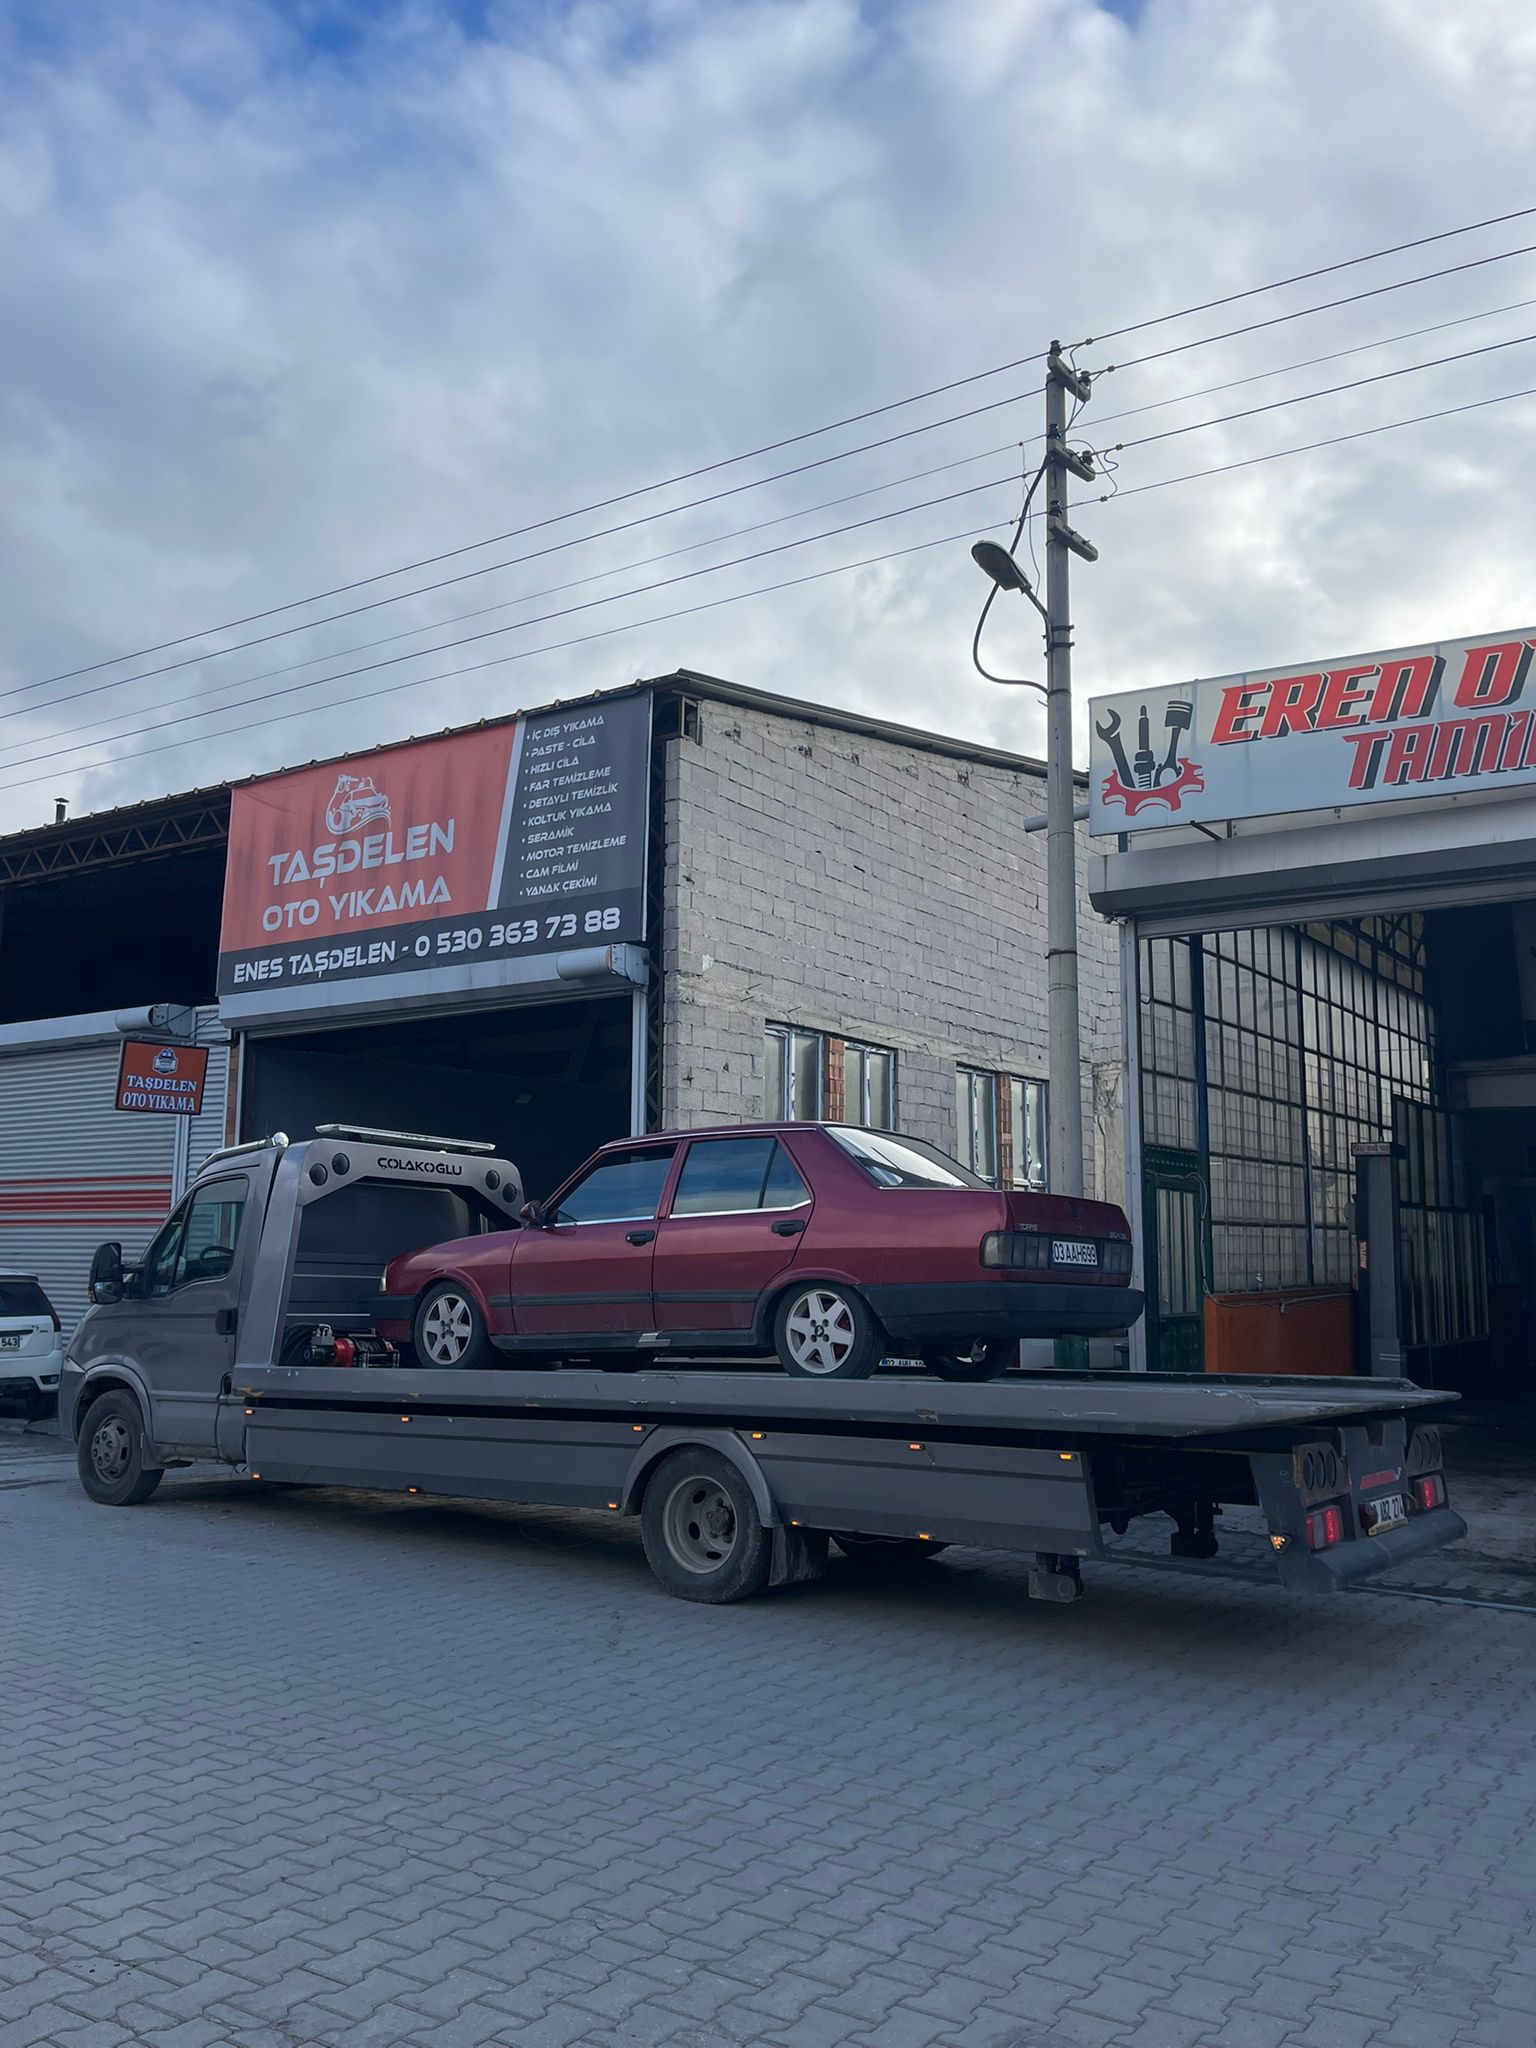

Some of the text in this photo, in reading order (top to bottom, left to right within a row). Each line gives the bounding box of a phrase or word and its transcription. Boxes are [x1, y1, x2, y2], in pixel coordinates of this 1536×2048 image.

[1210, 634, 1536, 745] EREN O
[532, 715, 604, 741] İÇ DIŞ YIKAMA
[531, 743, 564, 757] PASTE
[573, 735, 596, 748] CİLA
[530, 756, 579, 774] HIZLI CİLA
[529, 766, 612, 791] FAR TEMİZLEME
[529, 782, 619, 809] DETAYLI TEMİZLİK
[528, 802, 612, 826] KOLTUK YIKAMA
[528, 826, 575, 844] SERAMİK
[268, 818, 455, 888] TAŞDELEN
[526, 835, 627, 861] MOTOR TEMİZLEME
[526, 858, 579, 879] CAM FİLMİ
[525, 874, 598, 896] YANAK ÇEKİMİ
[262, 875, 451, 932] OTO YIKAMA
[233, 959, 283, 984] ENES
[288, 940, 396, 978] TAŞDELEN
[436, 928, 482, 955] 530
[489, 920, 539, 947] 363
[545, 913, 577, 939] 73
[583, 906, 620, 934] 88
[127, 1075, 197, 1092] TAŞDELEN
[123, 1092, 194, 1111] OTO YIKAMA
